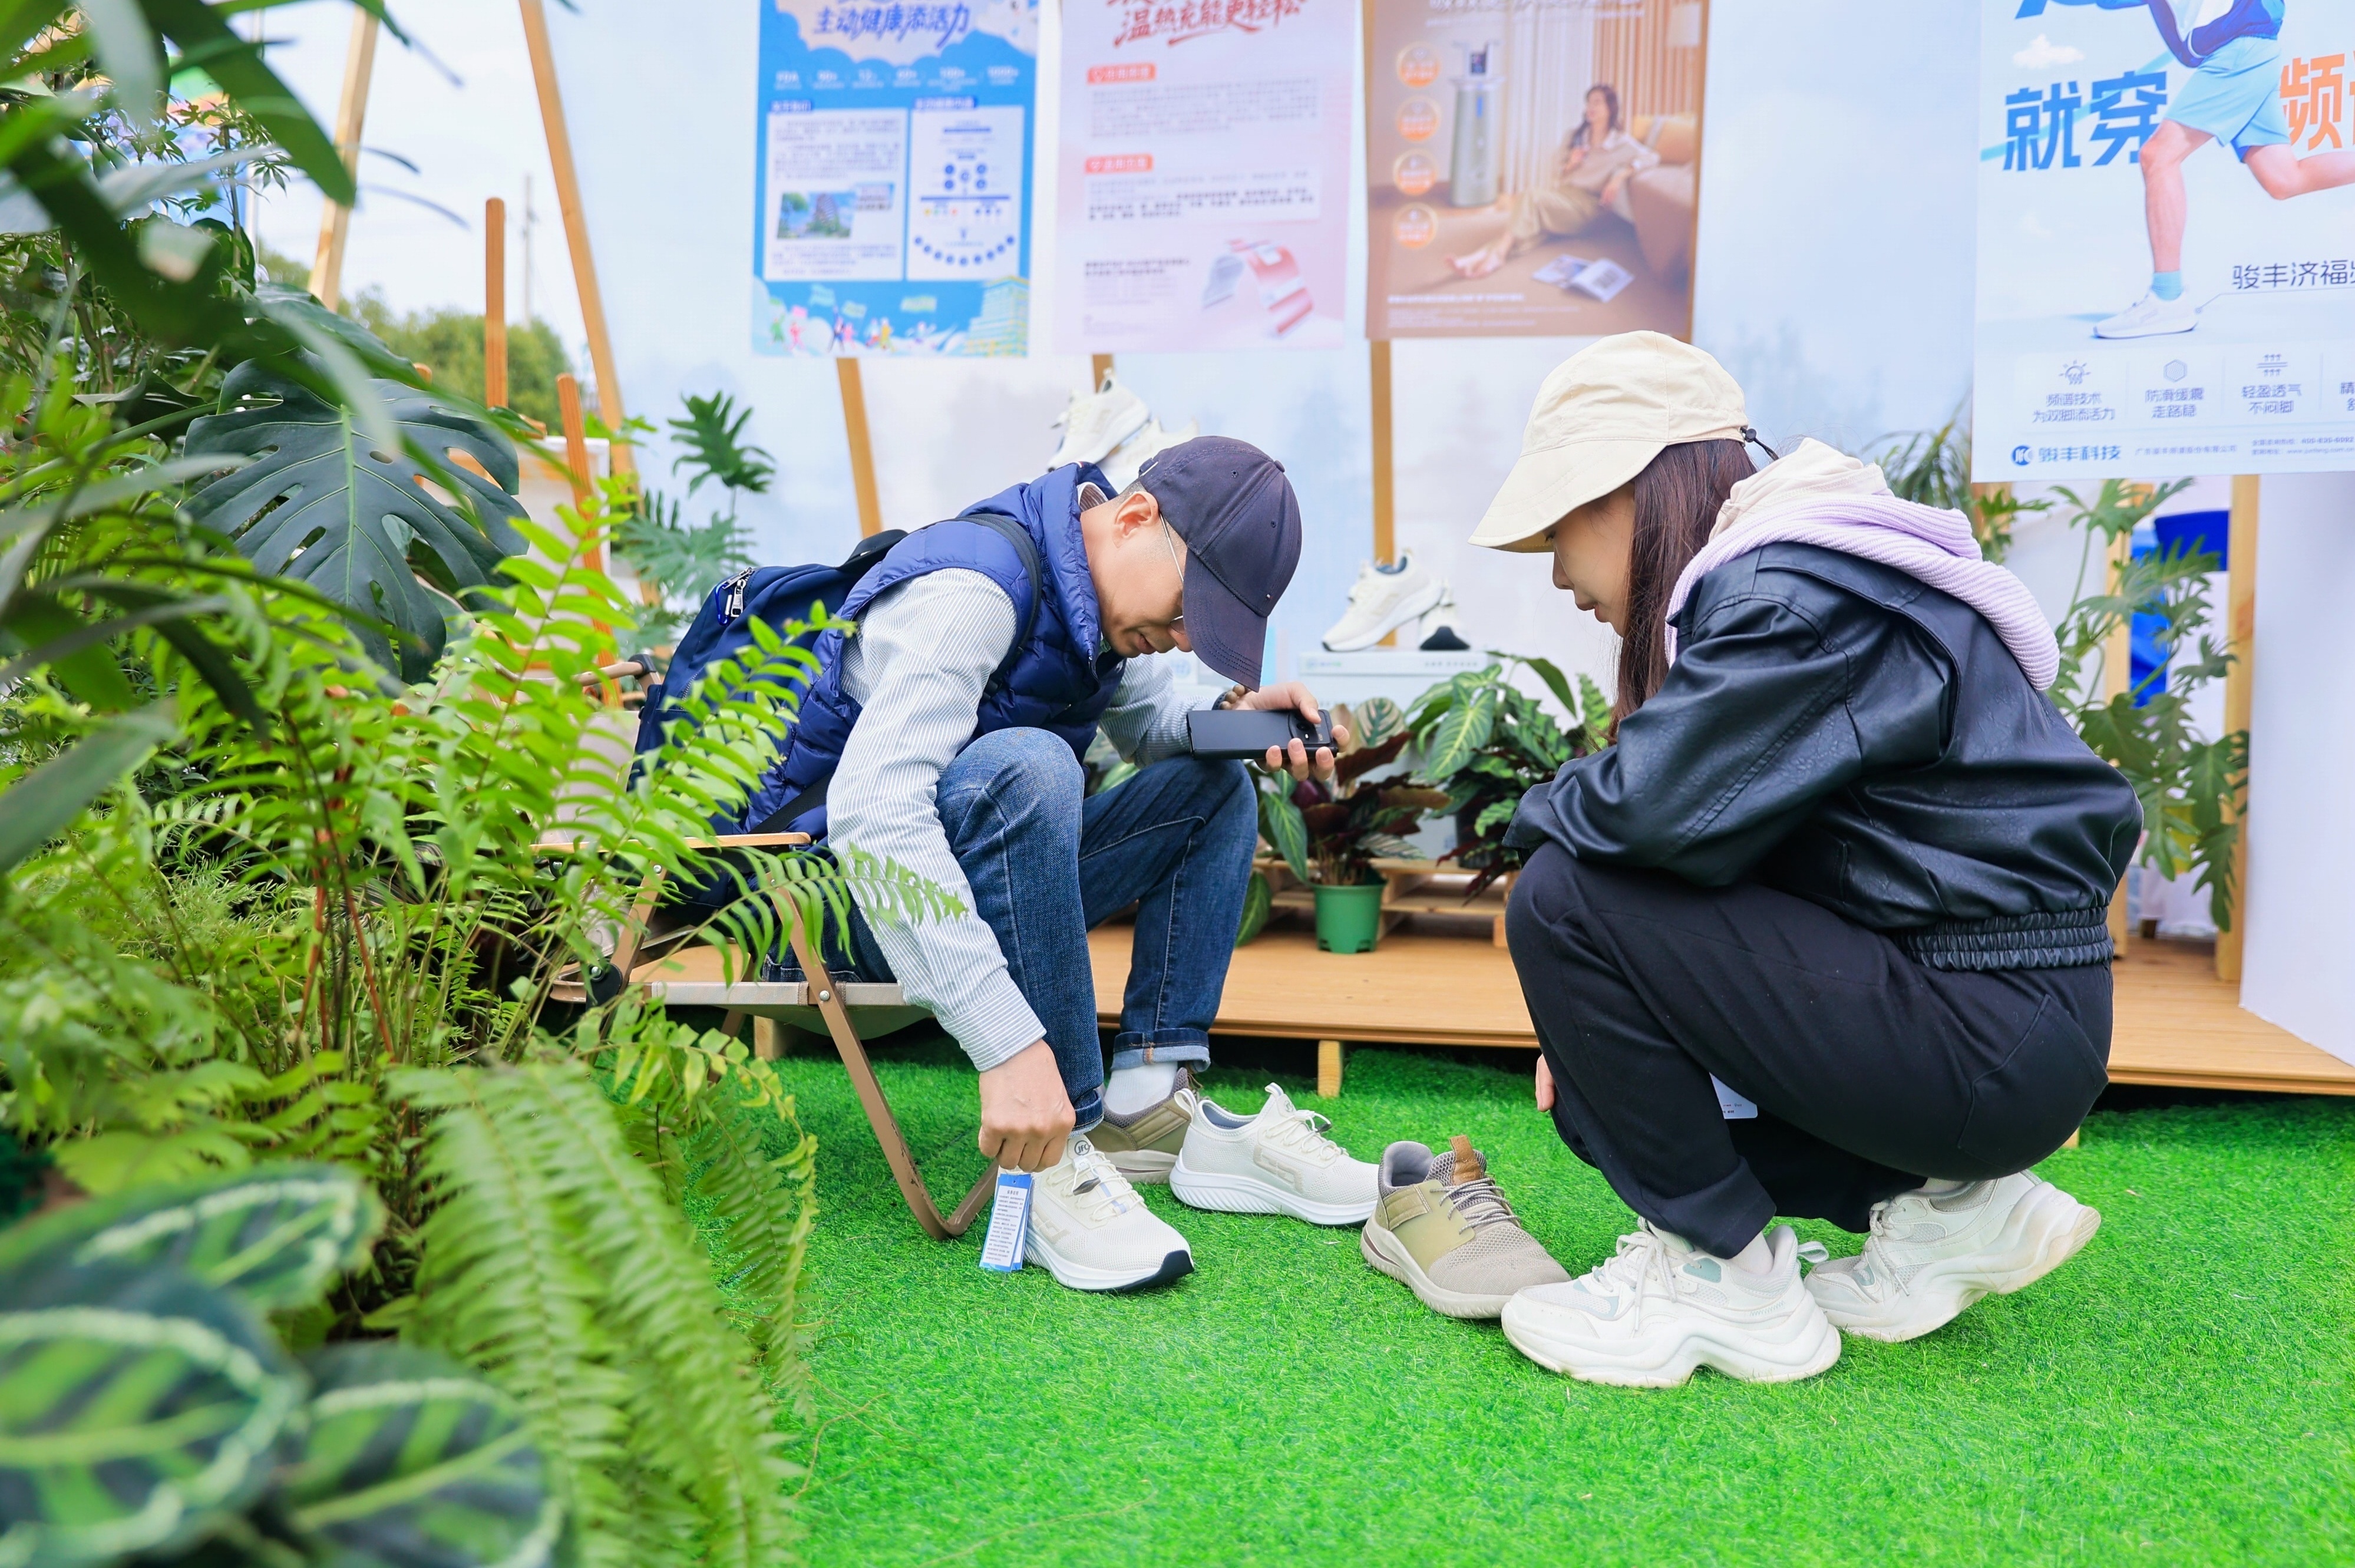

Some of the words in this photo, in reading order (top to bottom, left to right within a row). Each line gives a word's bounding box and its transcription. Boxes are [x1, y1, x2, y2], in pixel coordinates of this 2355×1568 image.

[2004, 71, 2167, 171] 就穿
[2279, 51, 2355, 152] 频
[2232, 260, 2355, 289] 骏丰济福
[2145, 388, 2204, 402] 防滑缓震
[2242, 384, 2302, 398] 轻盈透气
[2046, 393, 2102, 407] 频谱技术
[2249, 400, 2294, 414] 不闷脚
[2033, 407, 2115, 422] 为双脚添活力
[2152, 404, 2197, 418] 走路稳
[2039, 445, 2121, 463] 骏丰科技
